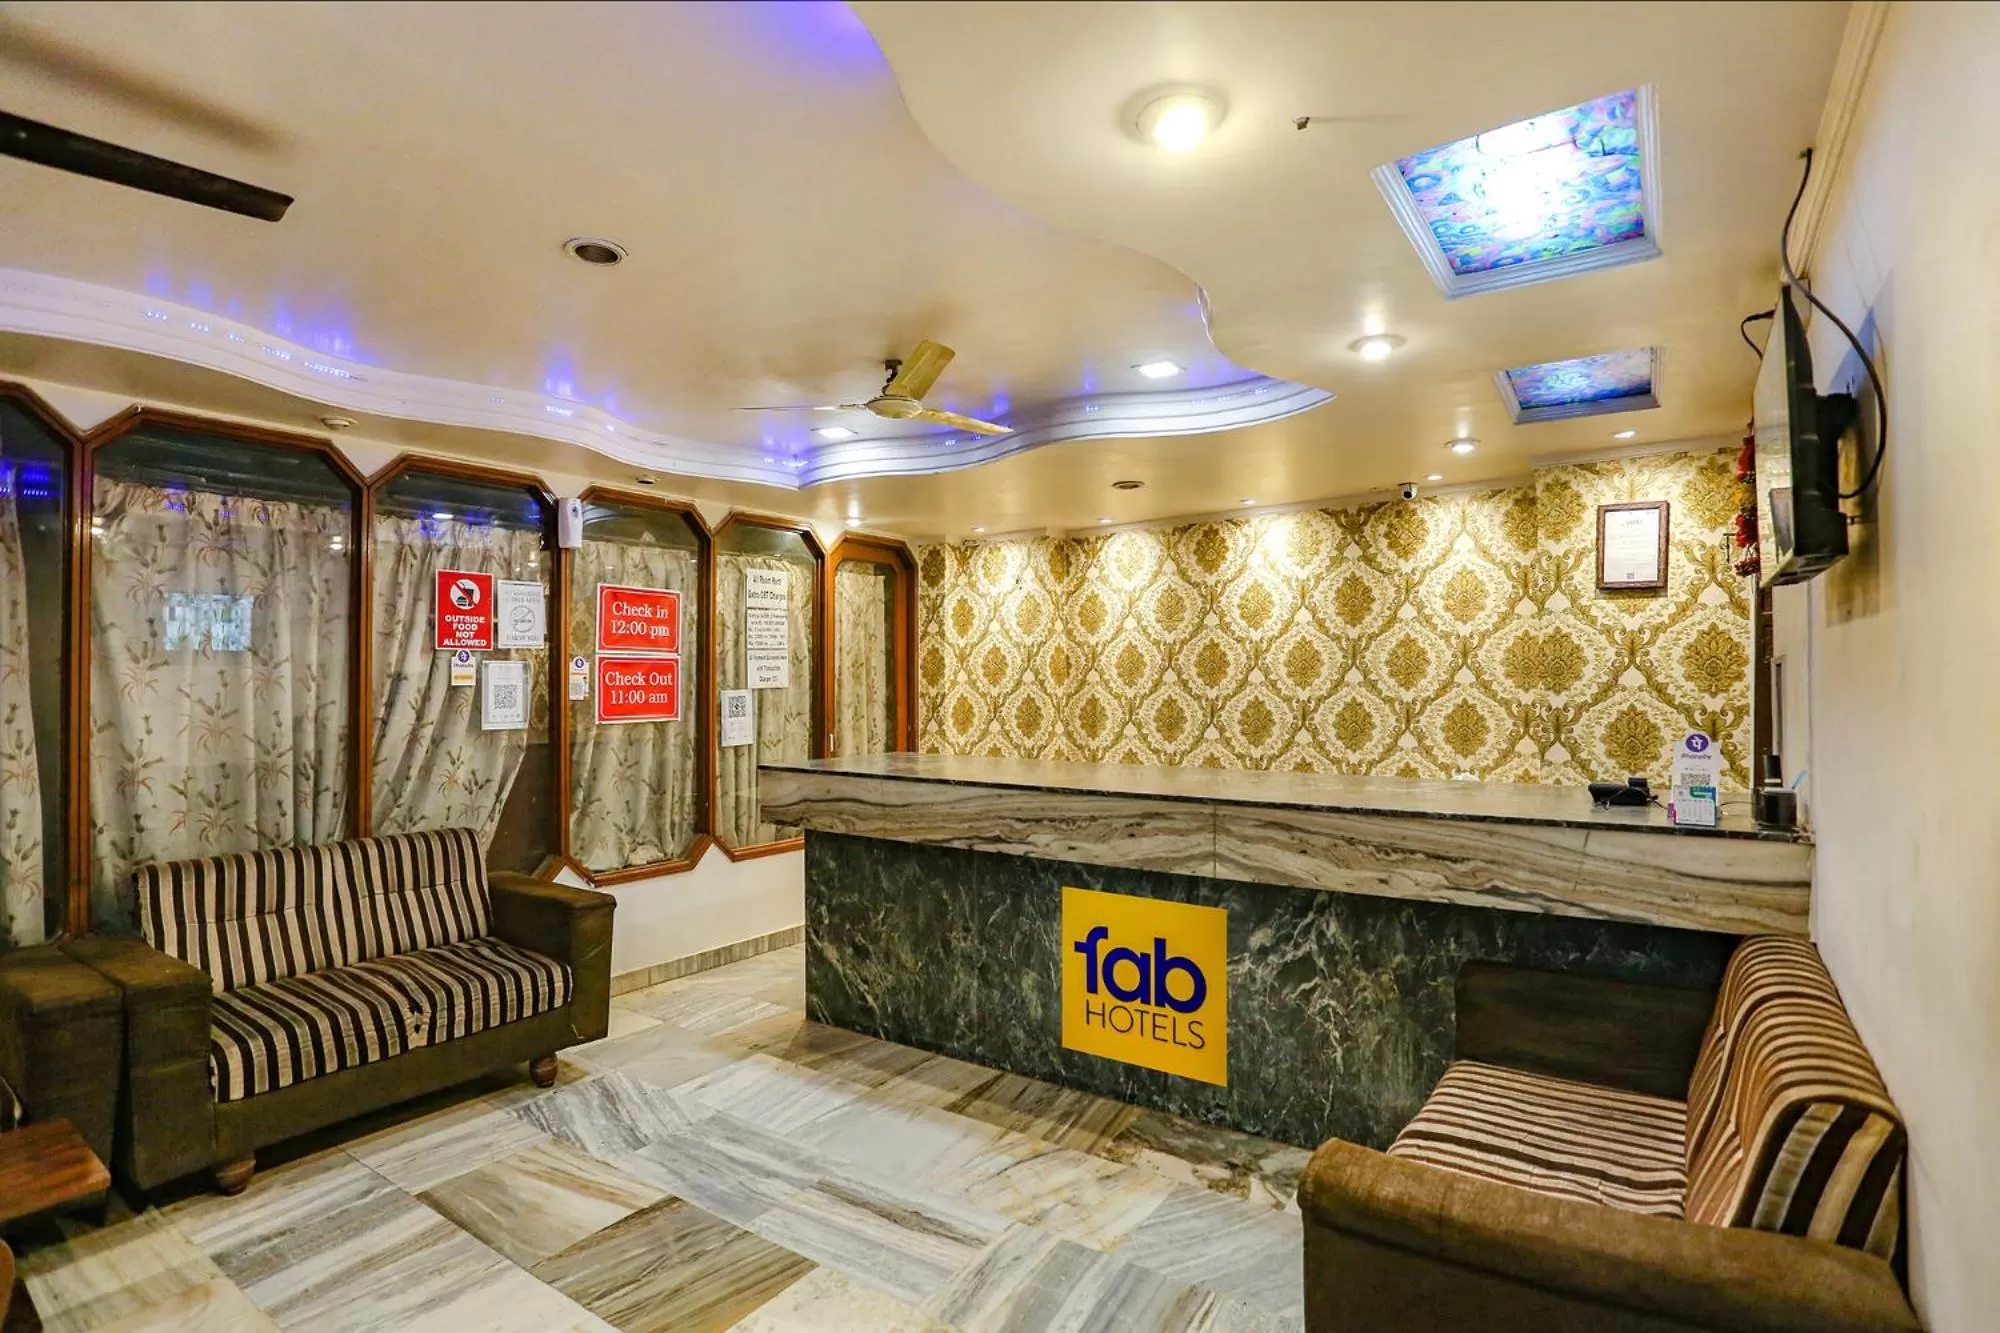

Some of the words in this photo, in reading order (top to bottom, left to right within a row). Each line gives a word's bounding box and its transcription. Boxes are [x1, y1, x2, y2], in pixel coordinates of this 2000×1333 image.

[612, 601, 653, 618] Check
[656, 605, 668, 619] In
[444, 614, 486, 624] OUTSIDE
[453, 622, 478, 631] FOOD
[611, 620, 647, 635] 12:00
[650, 624, 670, 639] pm
[456, 631, 475, 639] NOT
[443, 638, 487, 647] ALLOWED
[605, 671, 646, 686] Check
[649, 672, 673, 686] Out
[611, 690, 645, 704] 11:00
[649, 692, 668, 704] am
[1074, 926, 1208, 1014] fab
[1086, 999, 1206, 1050] HOTELS
